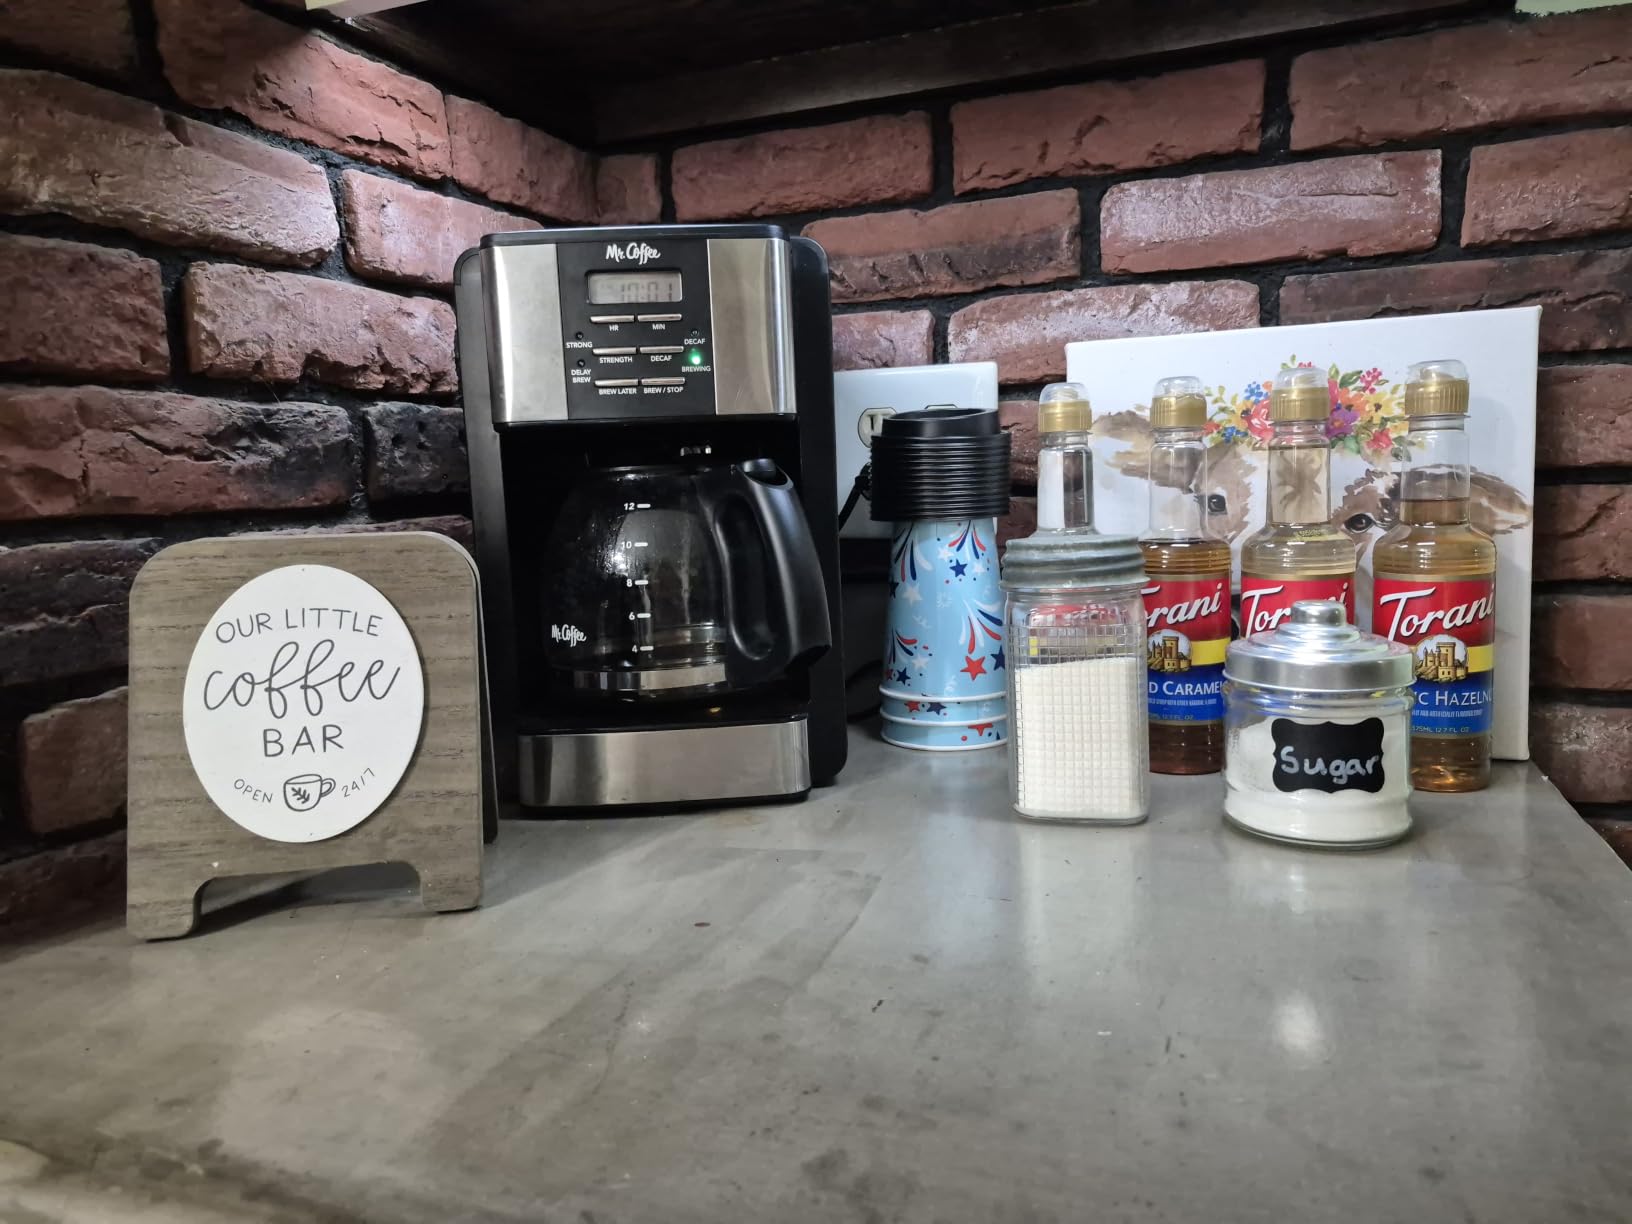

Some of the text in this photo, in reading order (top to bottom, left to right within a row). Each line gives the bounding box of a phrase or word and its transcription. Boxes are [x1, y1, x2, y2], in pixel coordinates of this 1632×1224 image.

[606, 242, 661, 265] Mr. Coffee
[609, 324, 619, 332] HR
[652, 323, 666, 331] MIN
[566, 341, 593, 349] STRONG
[599, 356, 633, 364] STRENGTH
[571, 368, 591, 376] DELAY
[681, 365, 711, 373] BREWING
[572, 376, 591, 384] BREW
[617, 387, 637, 395] LATER
[643, 386, 661, 394] BREW
[624, 502, 635, 511] 12
[621, 541, 632, 549] 10
[626, 578, 633, 587] 8
[1140, 582, 1223, 628] rani
[628, 611, 635, 620] 6
[1241, 582, 1348, 640] Tori
[1380, 583, 1495, 641] Torani
[215, 607, 383, 644] OUR LITTLE
[551, 624, 587, 647] Mr. Coffee
[632, 644, 638, 653] 4
[203, 639, 401, 719] coffee
[262, 724, 344, 757] BAR
[1280, 745, 1379, 785] Sugar
[233, 767, 376, 803] OPEN 24/7
